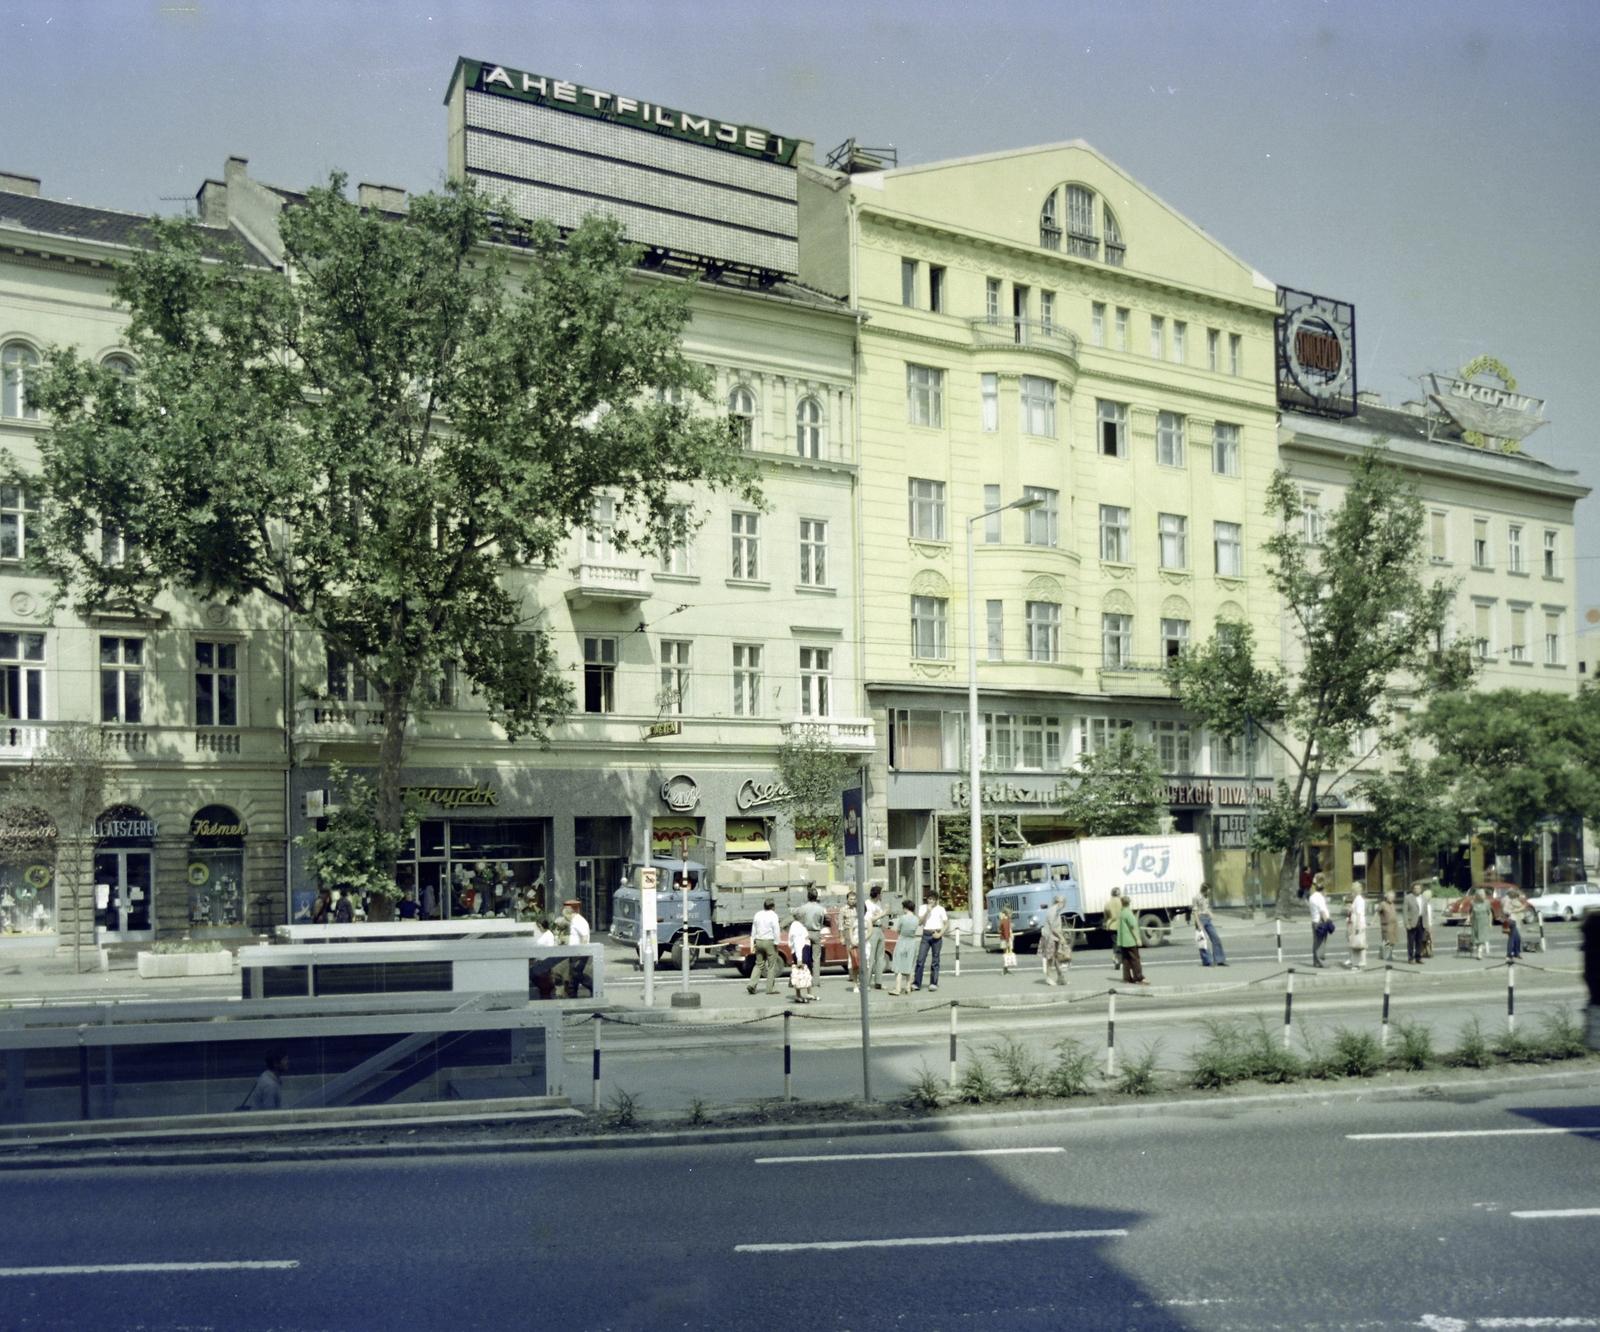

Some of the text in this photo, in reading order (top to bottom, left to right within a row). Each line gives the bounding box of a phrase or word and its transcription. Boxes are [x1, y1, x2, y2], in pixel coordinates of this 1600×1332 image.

[485, 66, 784, 156] A HÉT FILMJEI
[1219, 783, 1273, 805] DIVAÁRU
[90, 820, 160, 837] ILLATSZEREK
[1122, 842, 1171, 879] Tej
